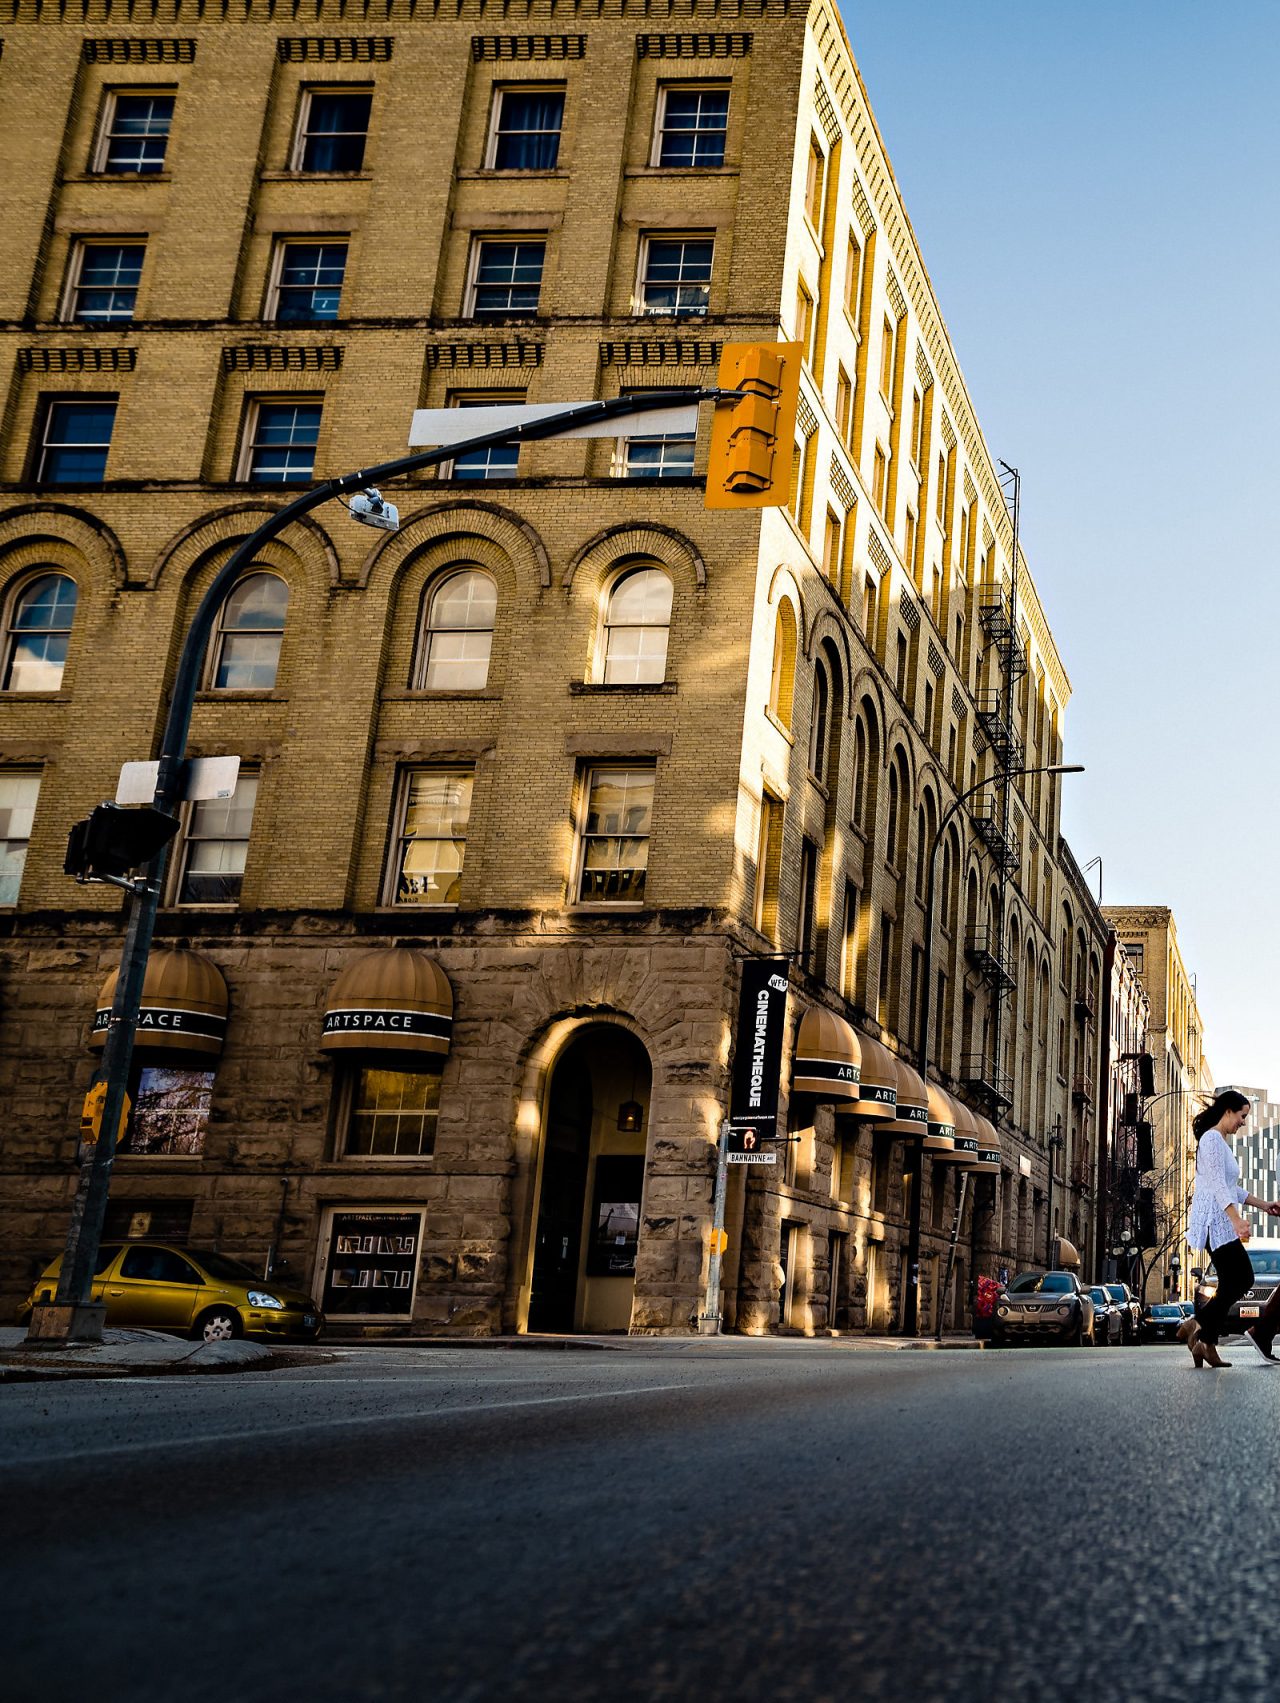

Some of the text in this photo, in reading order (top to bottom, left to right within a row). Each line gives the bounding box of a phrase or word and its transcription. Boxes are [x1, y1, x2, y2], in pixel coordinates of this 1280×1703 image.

[96, 1013, 182, 1027] ARACE
[326, 1015, 412, 1028] ARTSPACE
[749, 990, 769, 1107] CINEMATHEQUE
[838, 1067, 860, 1081] ARTS
[731, 1154, 765, 1162] BANNATYNE
